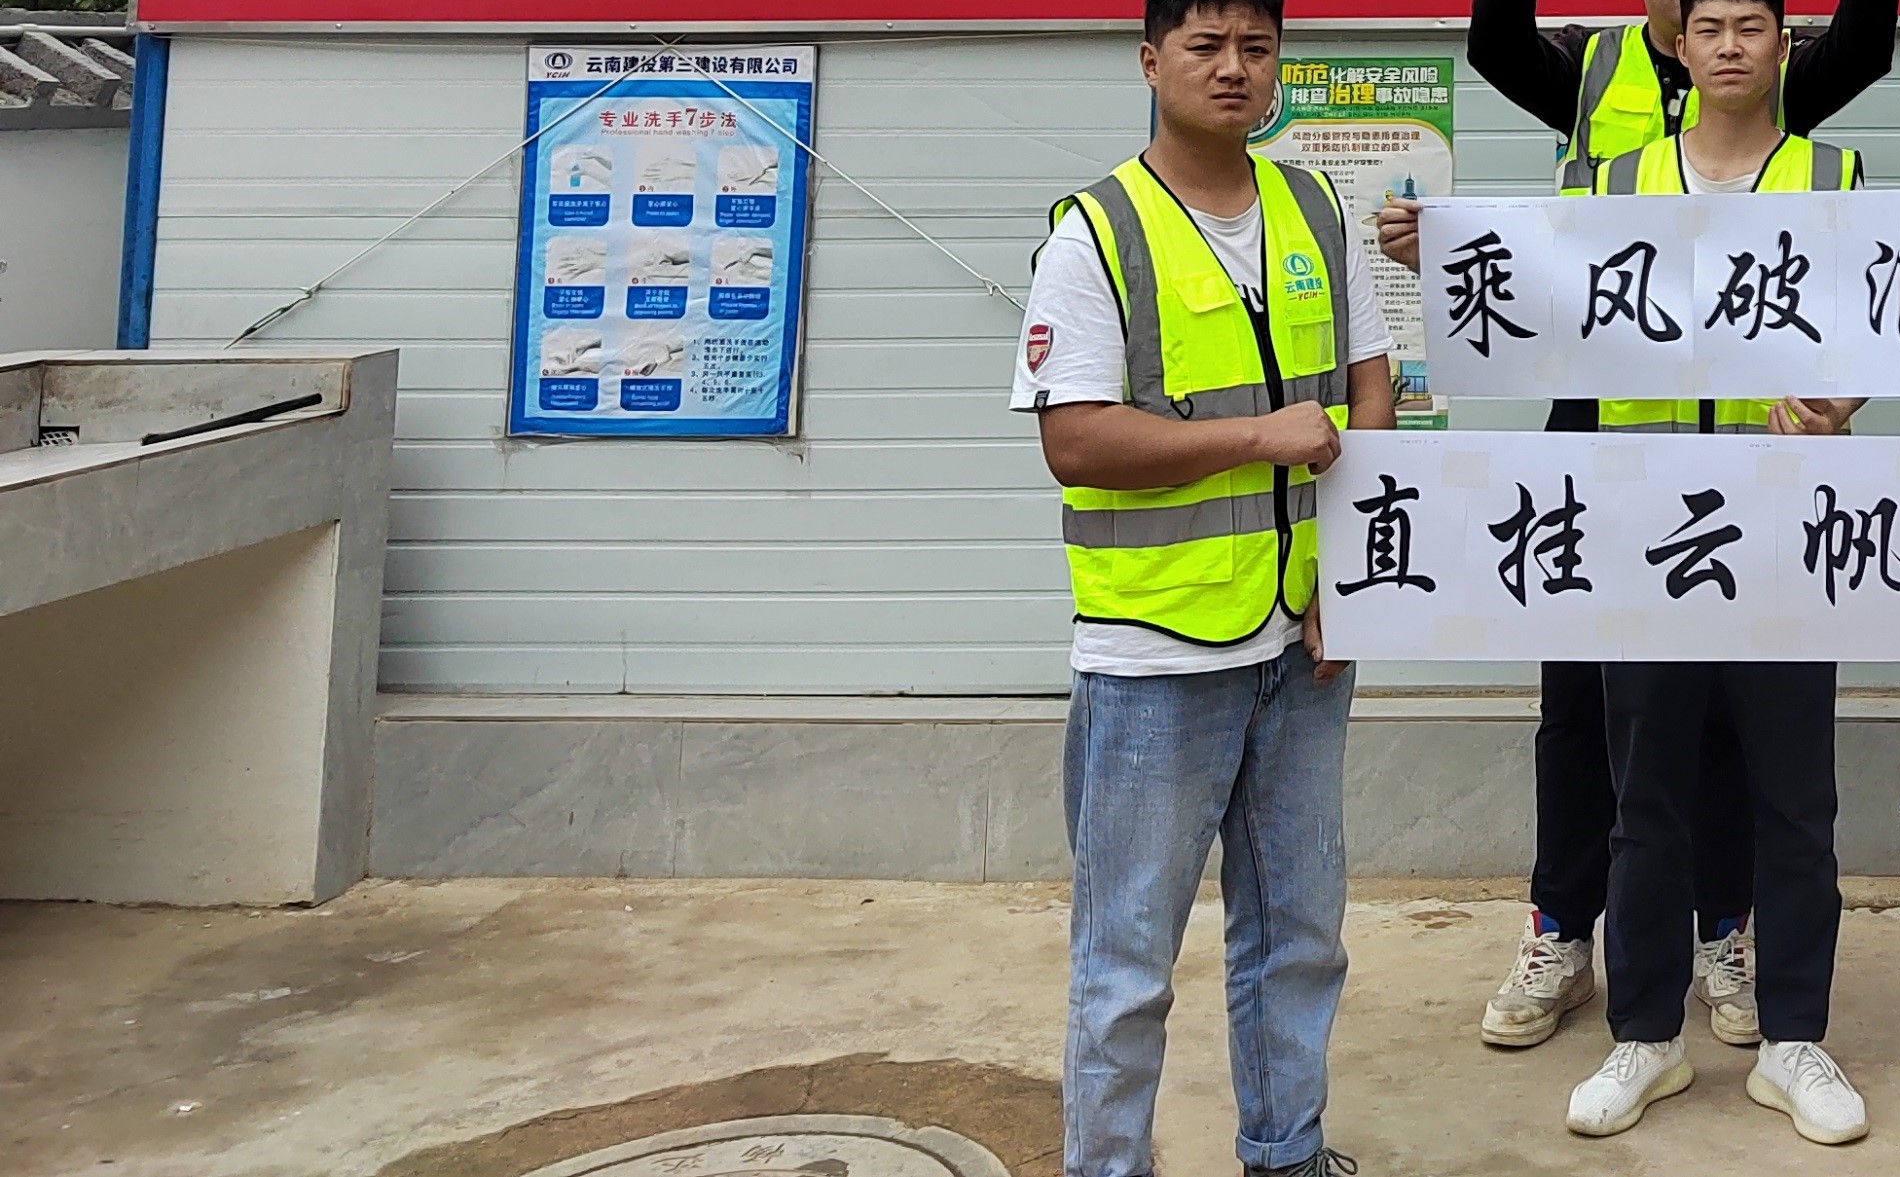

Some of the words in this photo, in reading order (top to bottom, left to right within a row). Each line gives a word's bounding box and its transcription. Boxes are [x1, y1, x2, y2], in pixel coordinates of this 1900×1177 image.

[586, 56, 798, 74] 云南建投第三建设有限公司
[1282, 63, 1438, 84] 防范化解安全风险
[545, 71, 570, 79] YCIH
[1291, 83, 1448, 104] 排查治理事故隐患
[599, 108, 737, 128] 专业洗手7步法
[1292, 131, 1421, 141] 风险分级管控与隐患排查治理
[1301, 143, 1411, 153] 双重预防机制建立的意义
[1284, 277, 1323, 294] 云南建投
[1298, 292, 1318, 301] YCIH
